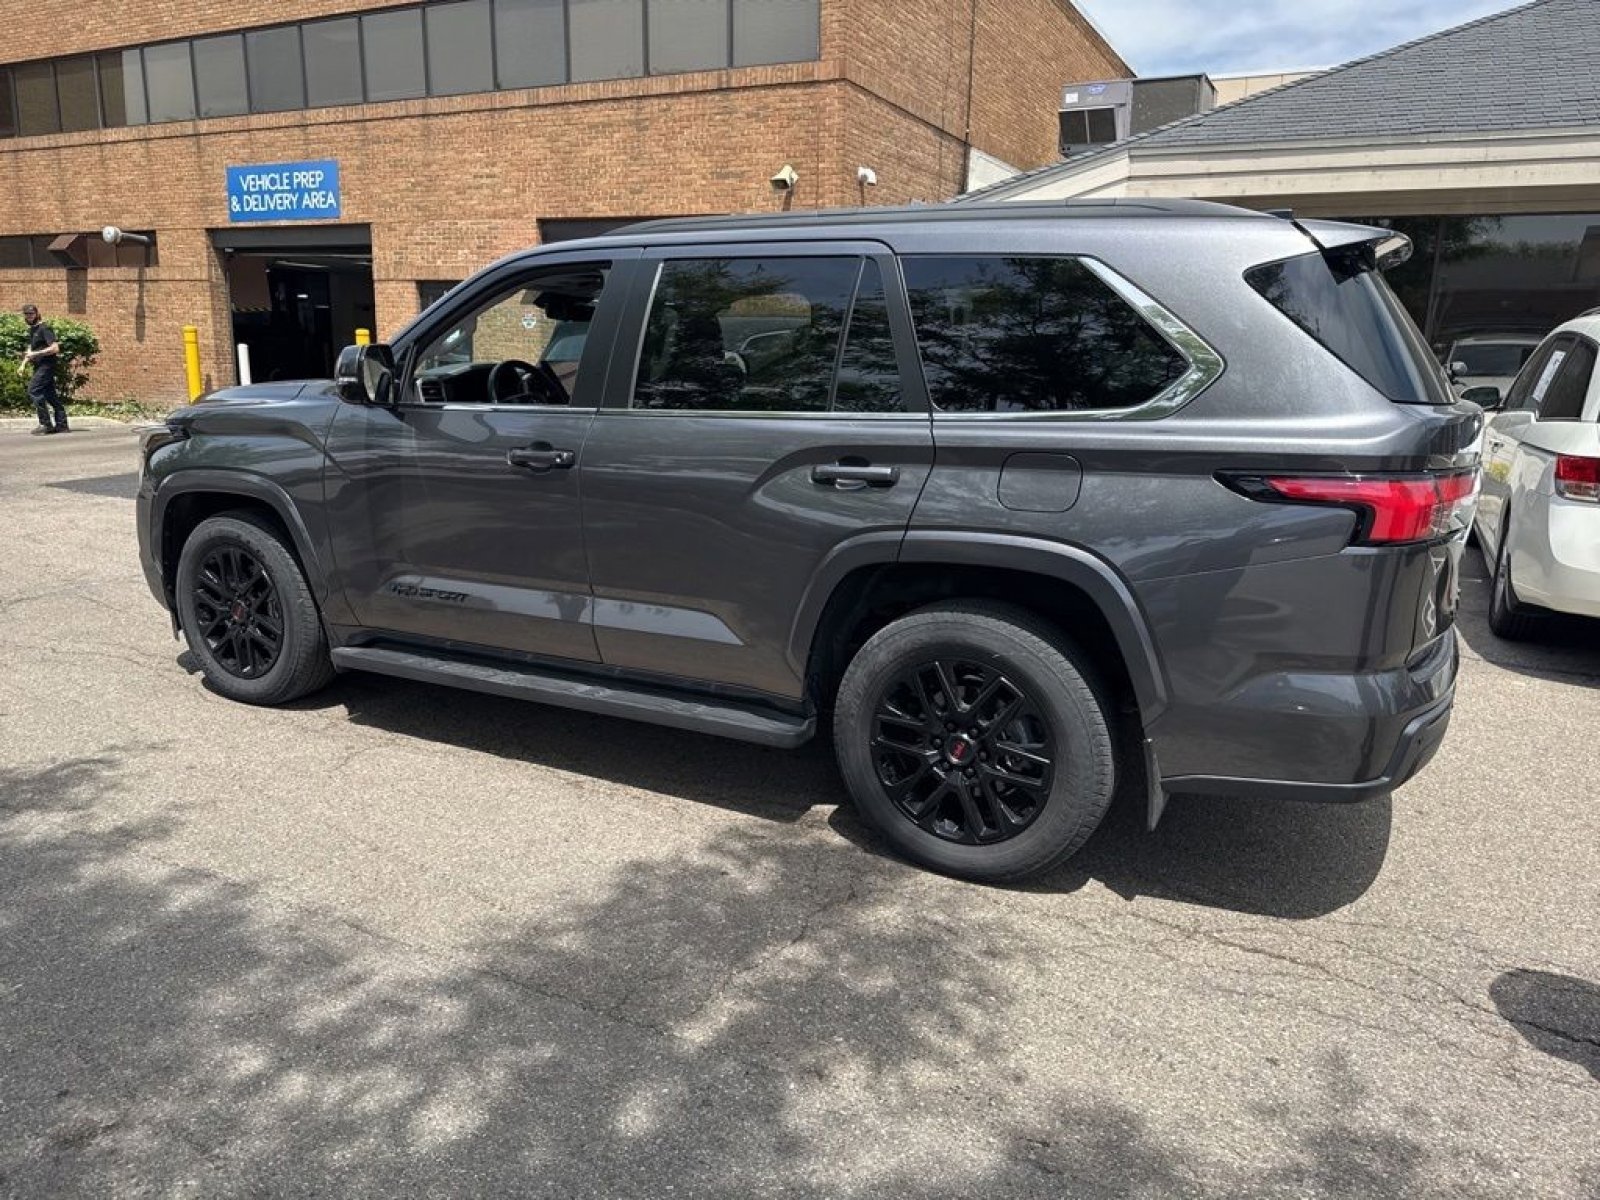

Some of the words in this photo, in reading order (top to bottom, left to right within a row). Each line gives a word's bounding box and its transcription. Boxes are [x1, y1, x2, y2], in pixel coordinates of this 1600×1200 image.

[239, 172, 291, 192] VEHICLE
[293, 169, 324, 189] PREP
[230, 195, 241, 212] &
[243, 192, 299, 212] DELIVERY
[302, 190, 337, 209] AREA
